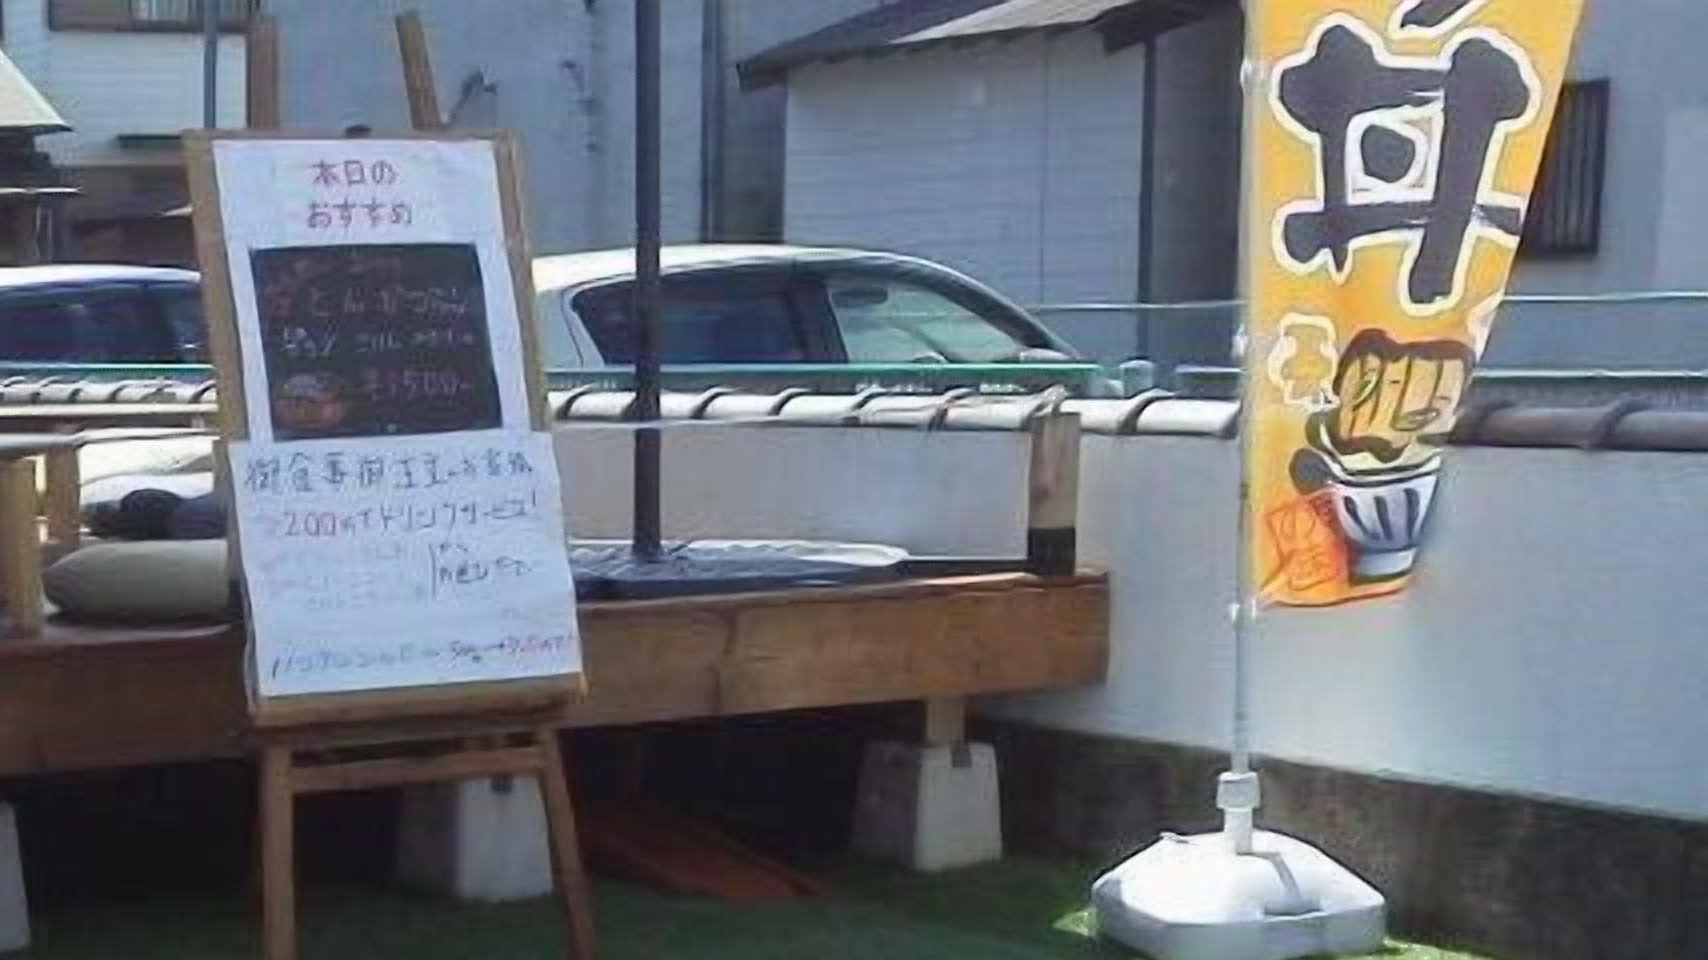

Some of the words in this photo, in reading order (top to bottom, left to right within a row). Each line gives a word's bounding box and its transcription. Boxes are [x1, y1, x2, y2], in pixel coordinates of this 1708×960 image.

[1272, 0, 1538, 314] 丼
[308, 160, 398, 186] 本日の
[306, 198, 412, 229] おすすめ
